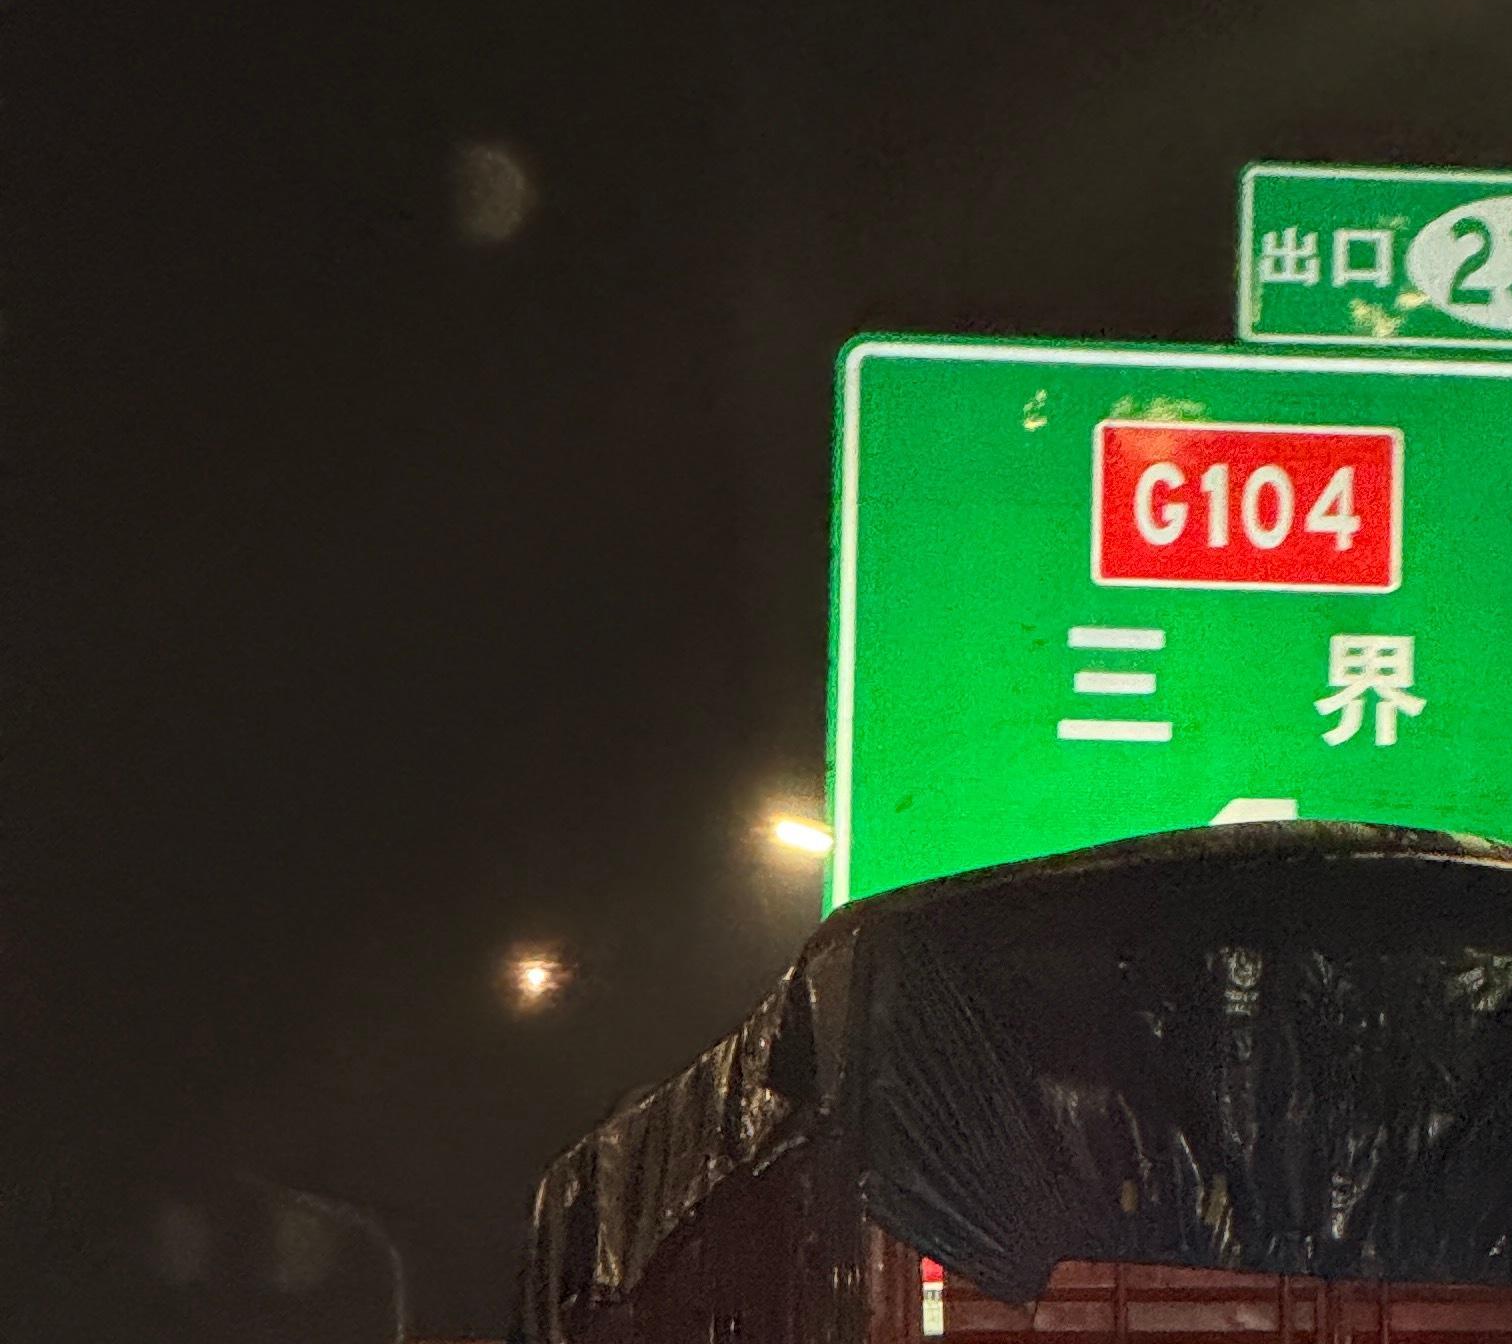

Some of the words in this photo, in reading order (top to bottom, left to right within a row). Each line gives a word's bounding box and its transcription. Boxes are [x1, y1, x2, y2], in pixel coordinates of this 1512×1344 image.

[1259, 227, 1394, 289] 出口
[1133, 462, 1362, 552] G104
[1056, 625, 1428, 747] 三界
